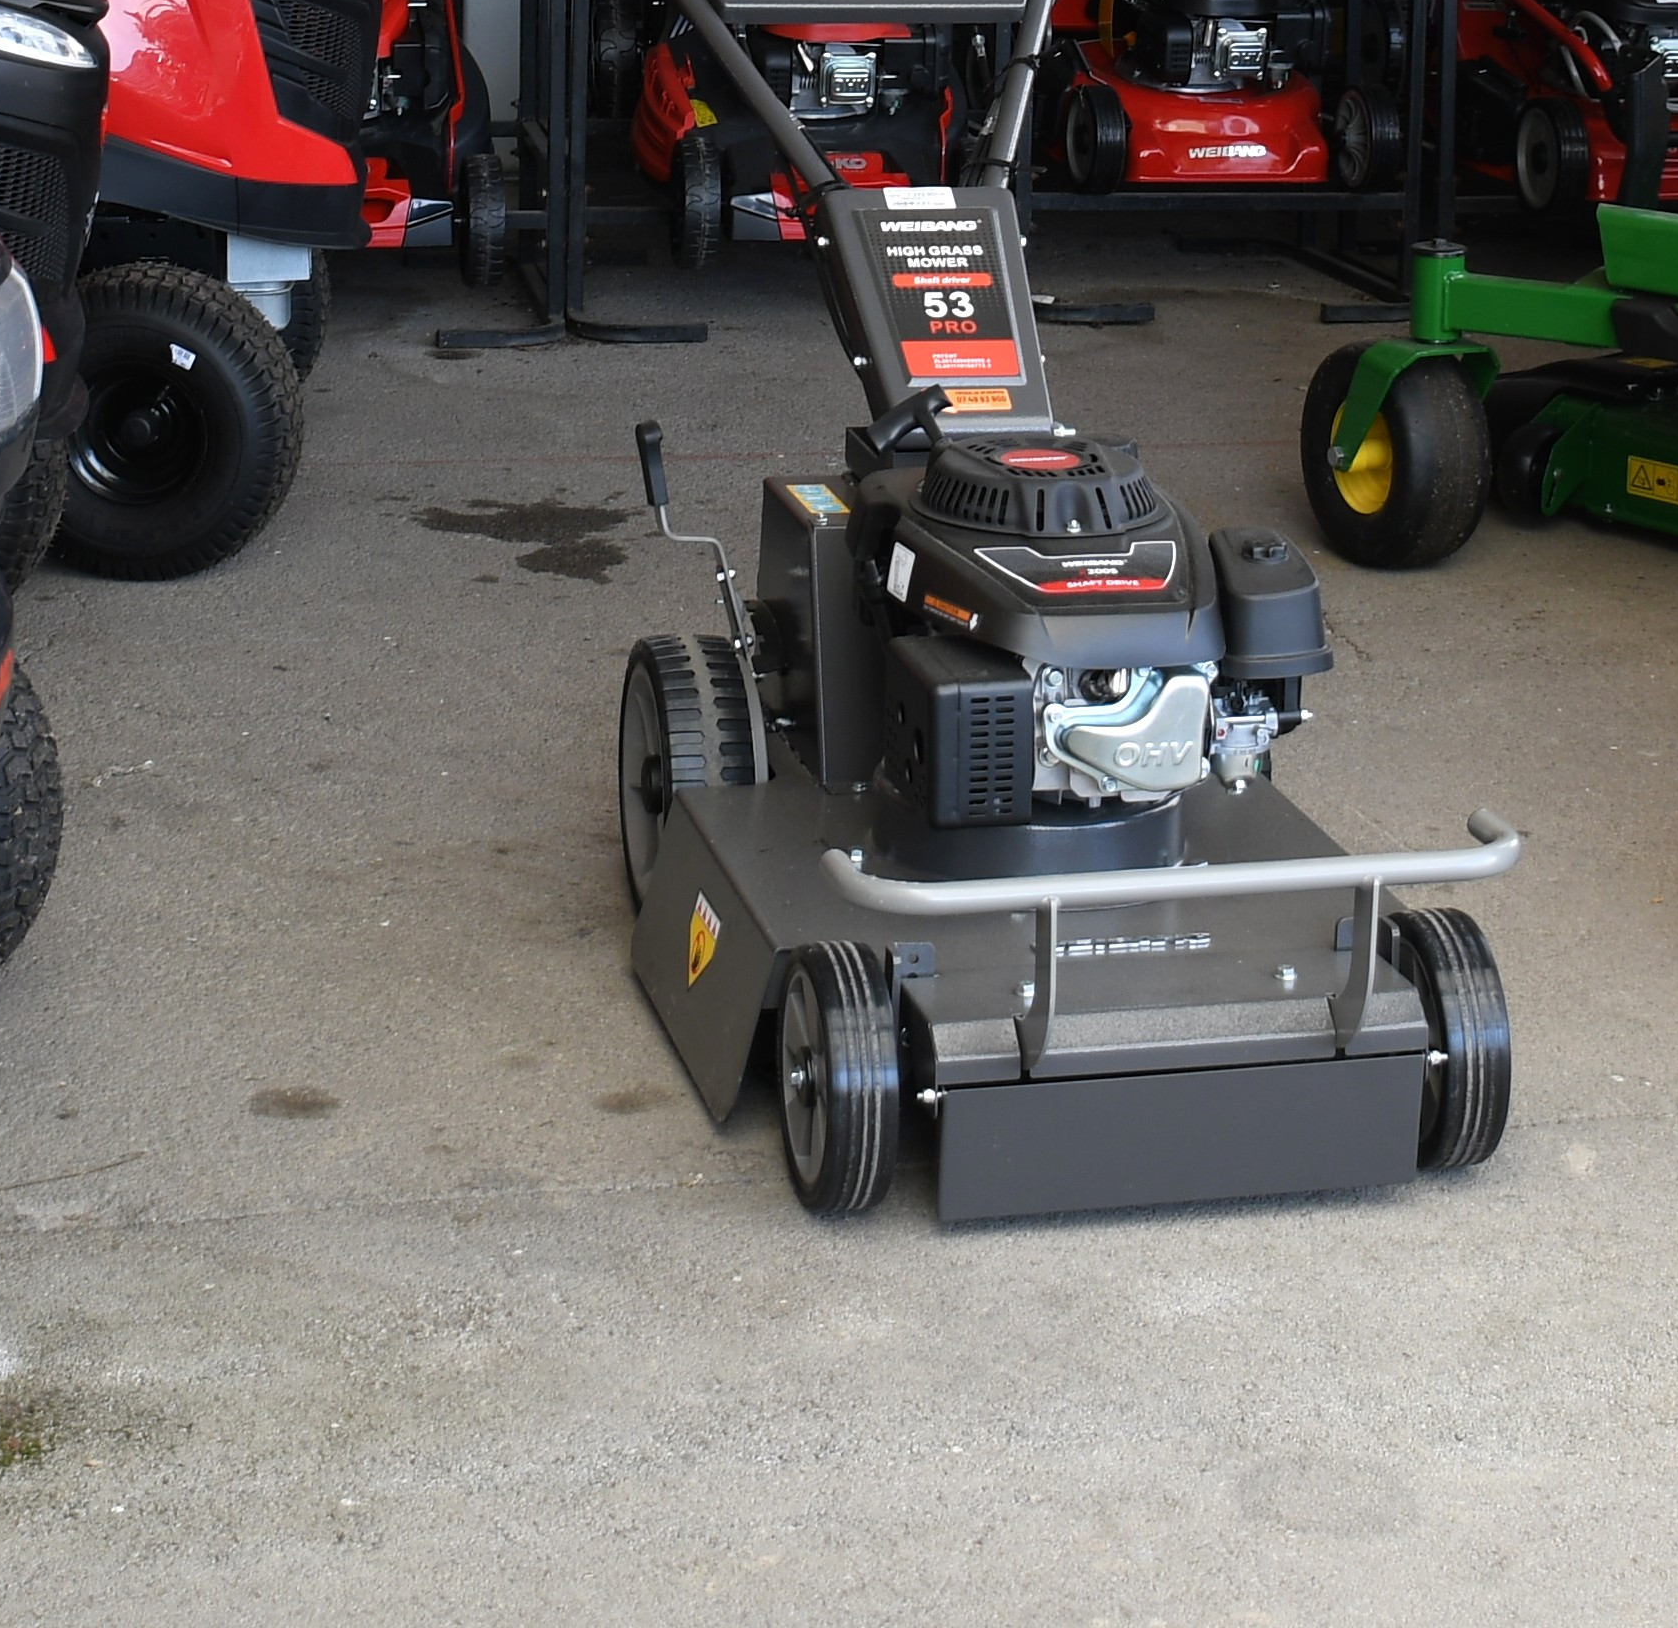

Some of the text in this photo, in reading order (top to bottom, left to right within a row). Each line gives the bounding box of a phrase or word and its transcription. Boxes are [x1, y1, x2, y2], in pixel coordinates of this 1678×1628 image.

[1188, 145, 1268, 160] WEIBANG
[880, 220, 979, 233] WEIBANG
[886, 245, 984, 257] HIGH GRASS
[907, 257, 970, 269] MOWER
[913, 275, 972, 285] Shaft driver
[923, 291, 975, 319] 53
[929, 320, 978, 335] PRO
[1112, 739, 1195, 770] OHV
